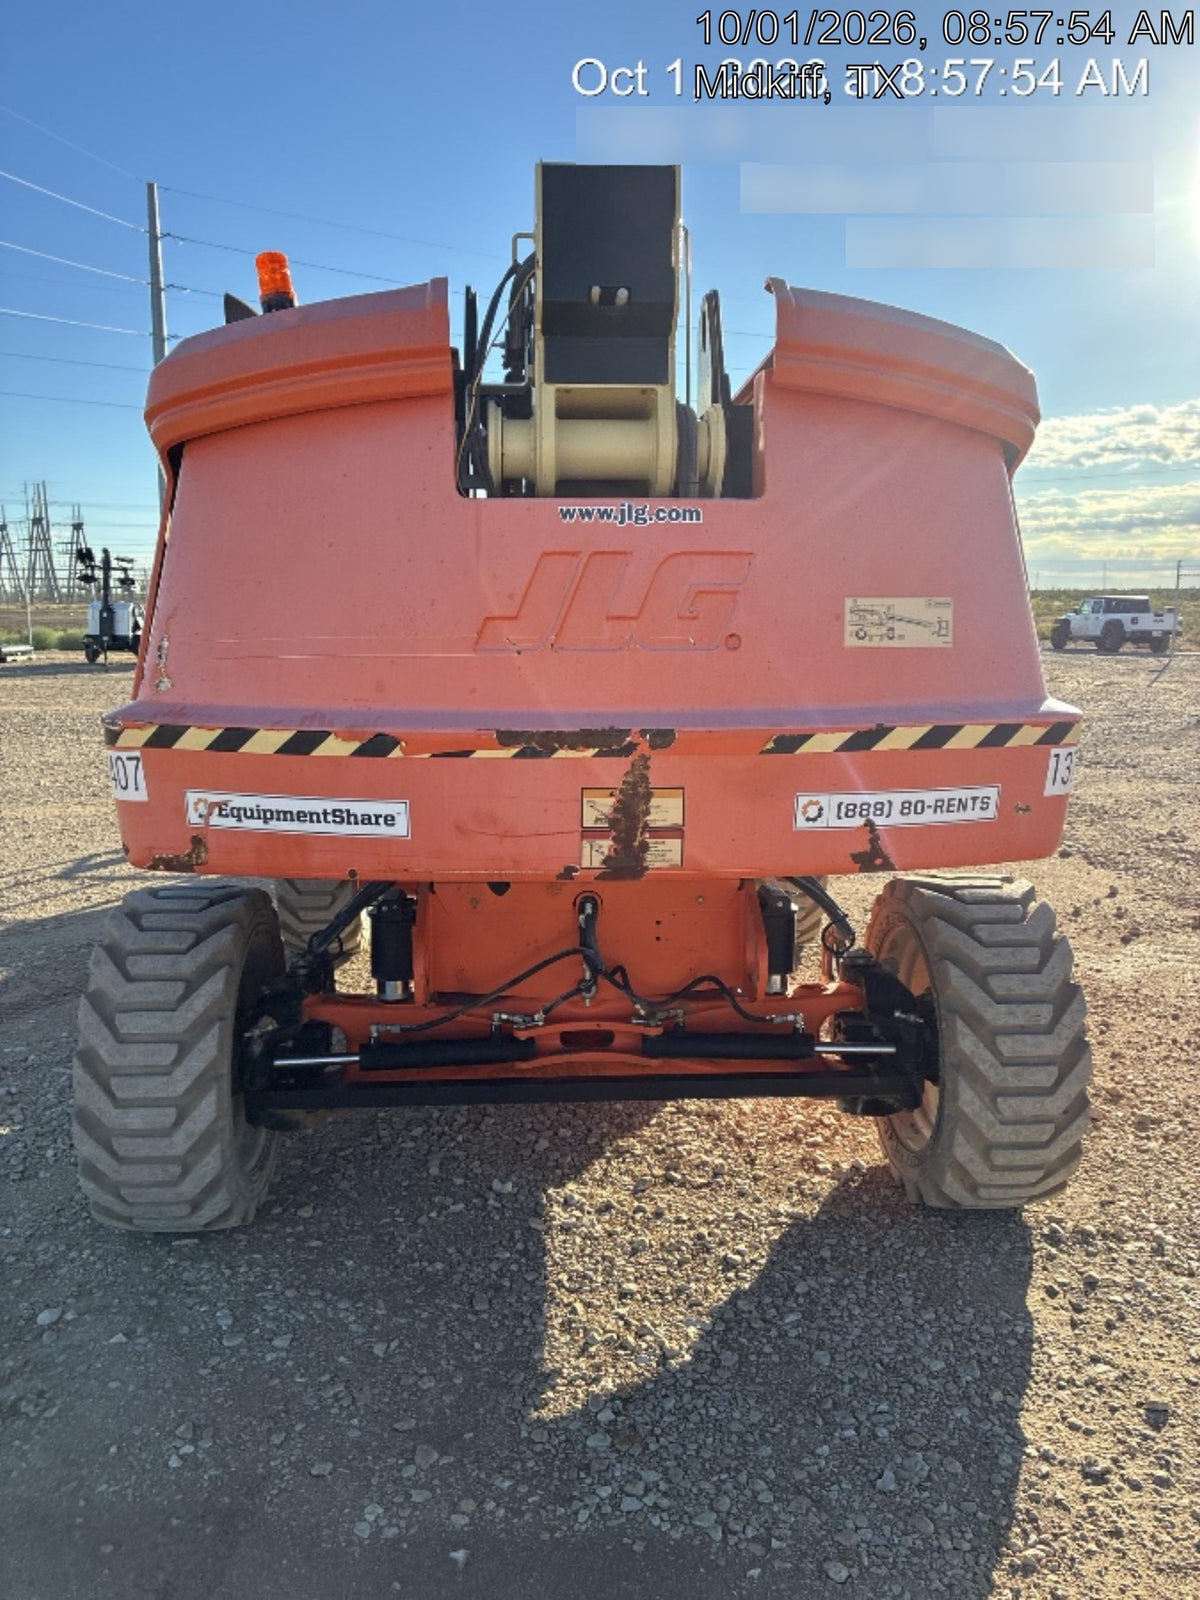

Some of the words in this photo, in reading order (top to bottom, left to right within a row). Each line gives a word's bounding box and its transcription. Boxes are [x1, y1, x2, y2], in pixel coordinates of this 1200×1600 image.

[558, 502, 703, 527] www.jlg.com
[216, 802, 397, 827] EquipmentShare
[836, 800, 893, 820] (888)
[899, 794, 992, 816] 80-RENTS
